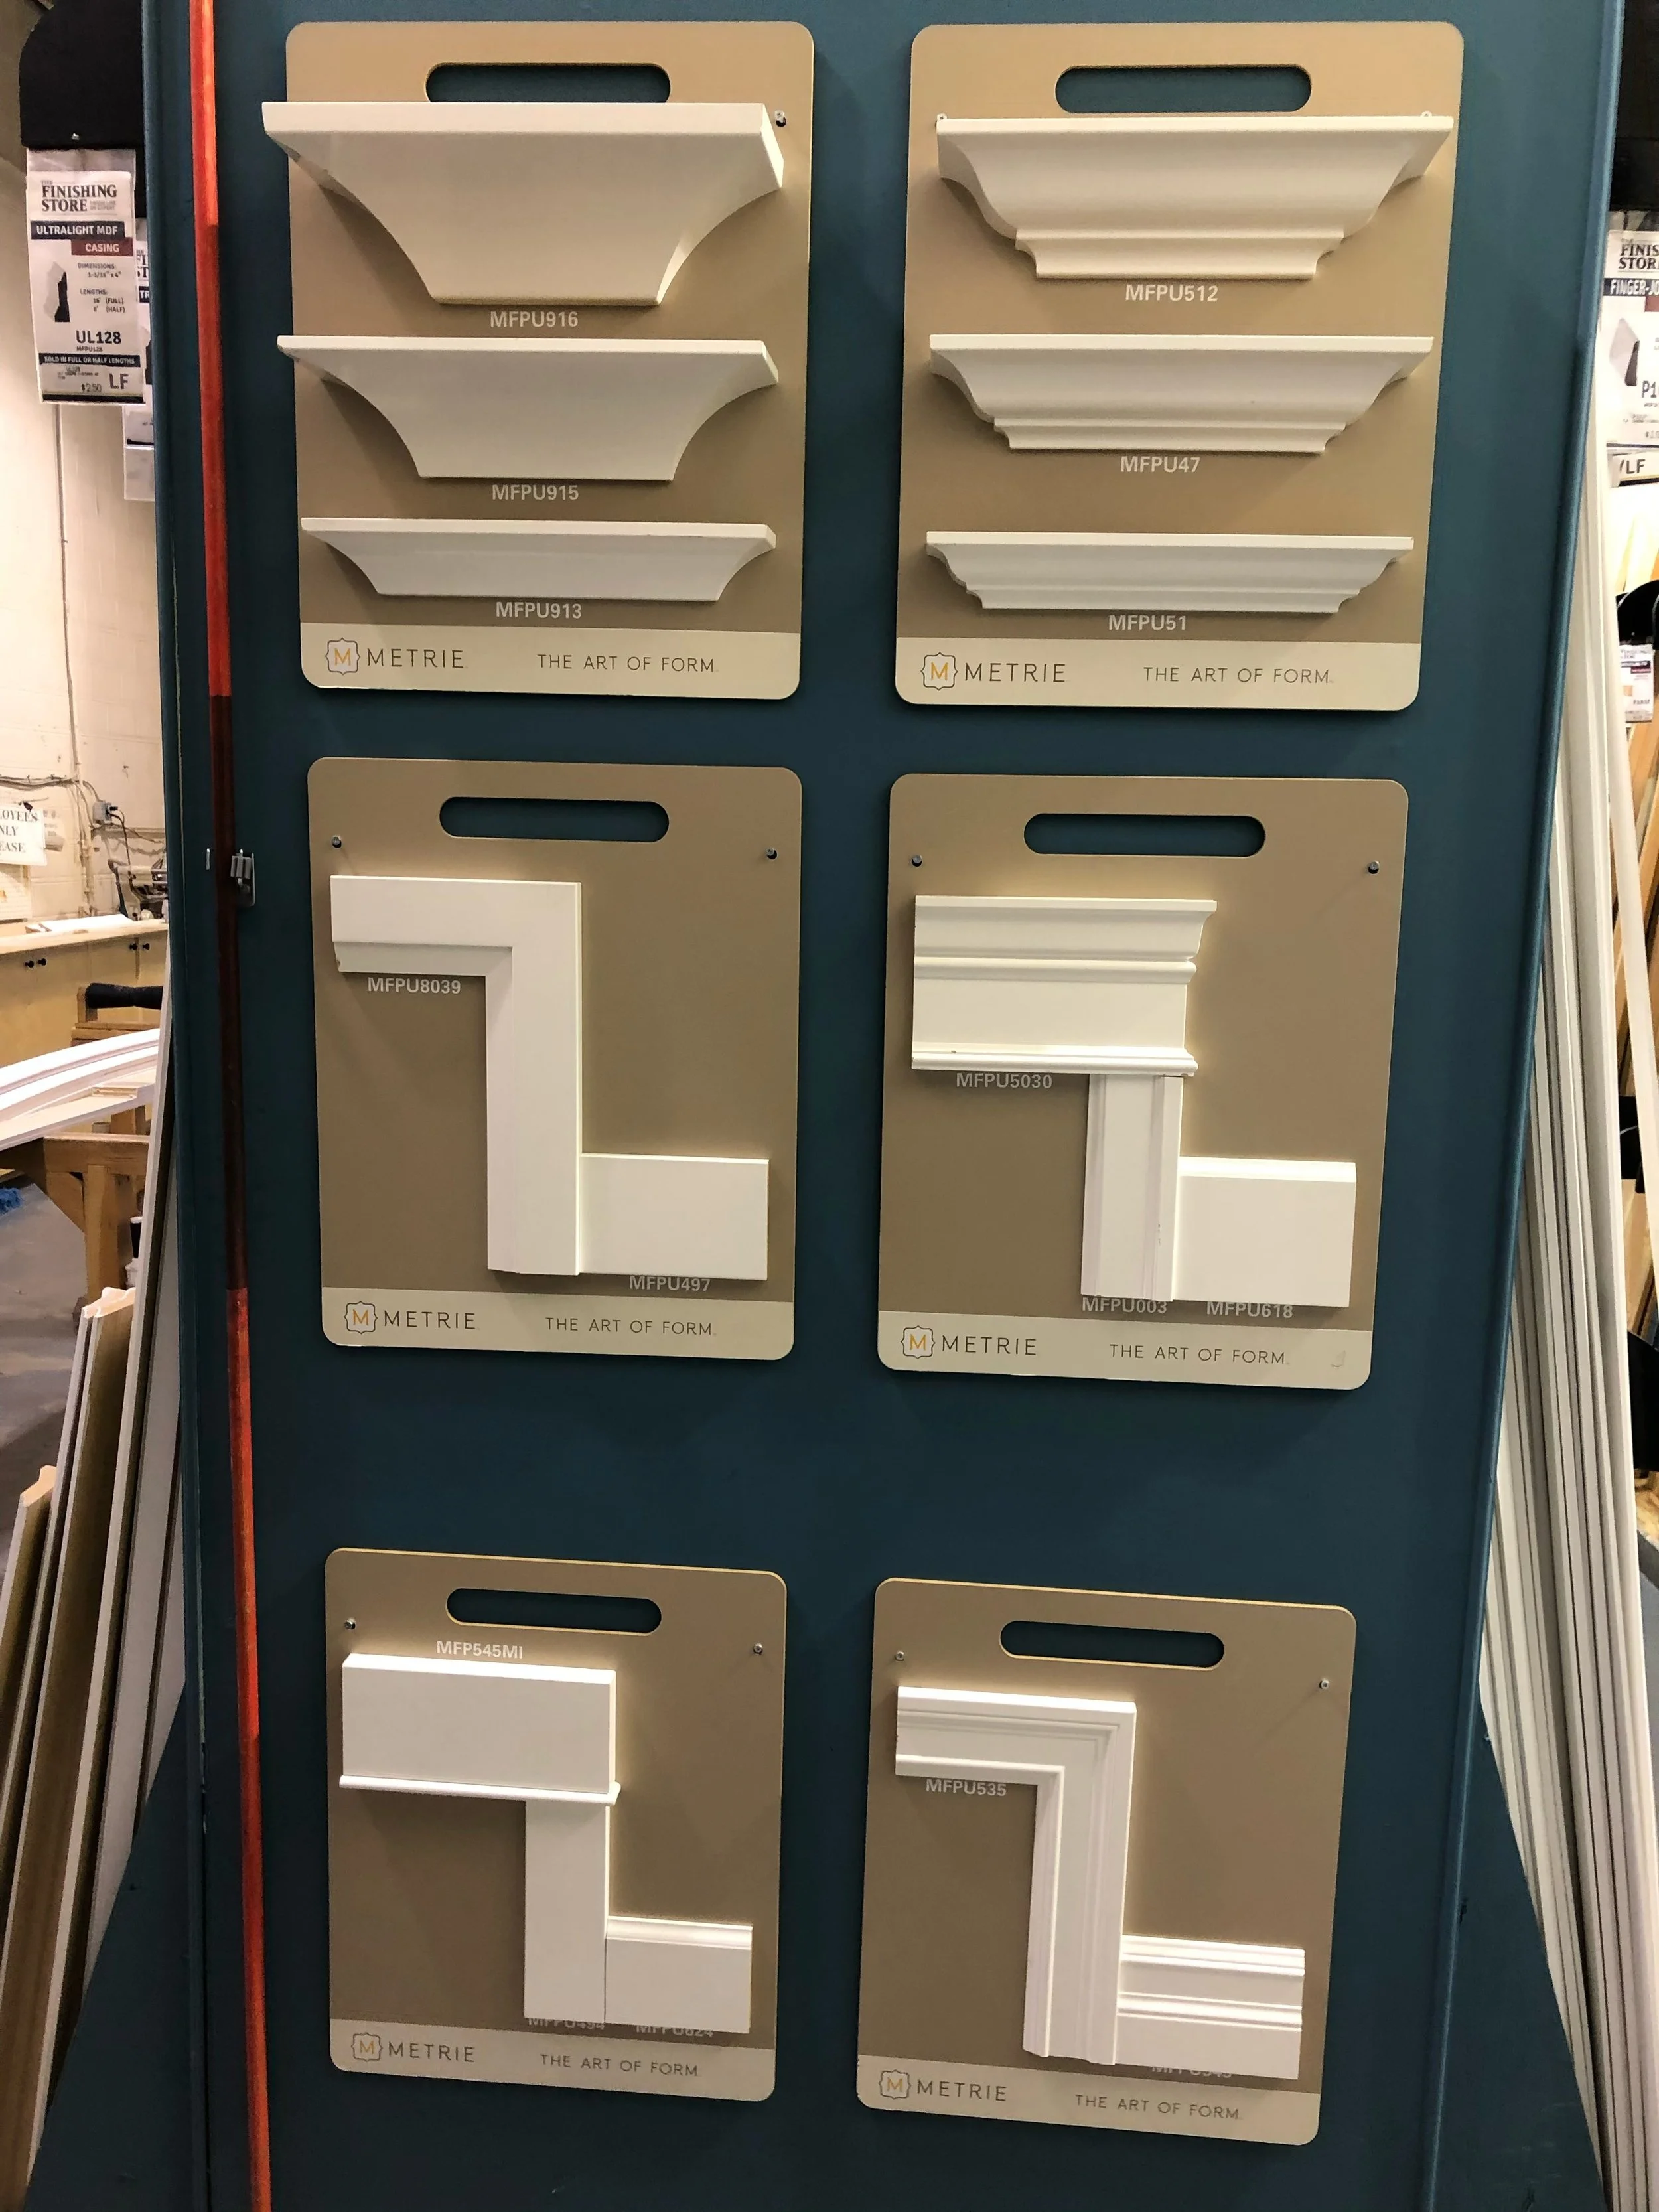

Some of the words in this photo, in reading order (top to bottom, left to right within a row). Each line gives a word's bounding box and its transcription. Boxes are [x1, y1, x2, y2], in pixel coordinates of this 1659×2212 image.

[41, 184, 117, 198] FINISHING
[41, 198, 88, 212] STORE
[36, 225, 94, 235] ULTRALIGHT
[96, 225, 118, 235] MDF
[85, 243, 120, 253] CASING
[1125, 283, 1219, 303] MFPU512
[490, 311, 579, 328] MFPU916
[76, 329, 122, 344] UL128
[109, 373, 129, 390] LF
[1120, 456, 1200, 473] MFPU47
[492, 484, 579, 501] MFPU915
[496, 601, 582, 619] MFPU913
[1108, 615, 1187, 631] MFPU51
[366, 648, 464, 669] METRIE
[537, 654, 573, 670] THE
[583, 655, 618, 670] ART
[627, 656, 652, 671] OF
[661, 657, 714, 673] FORM
[964, 662, 1066, 683] METRIE
[1143, 666, 1180, 682] THE
[1190, 667, 1228, 682] ART
[1237, 668, 1263, 683] OF
[1273, 668, 1329, 684] FORM
[0, 810, 40, 822] OYEES
[367, 976, 462, 995] MFPU8039
[956, 1072, 1053, 1090] MFPU5030
[629, 1275, 711, 1292] MFPU497
[1082, 1297, 1168, 1315] MFPU003
[1206, 1301, 1294, 1319] MFPU618
[384, 1309, 476, 1330] METRIE
[545, 1317, 579, 1331] THE
[589, 1319, 622, 1333] ART
[630, 1320, 653, 1334] OF
[662, 1321, 712, 1336] FORM
[942, 1335, 1037, 1356] METRIE
[1109, 1343, 1144, 1359] THE
[1154, 1346, 1190, 1361] ART
[1198, 1347, 1223, 1362] OF
[1232, 1349, 1285, 1365] FORM
[436, 1639, 524, 1660] MFP545MI
[926, 1778, 1007, 1797] MFPU535
[388, 2040, 476, 2063] METRIE
[540, 2053, 572, 2068] THE
[580, 2057, 612, 2071] ART
[619, 2059, 642, 2073] OF
[650, 2061, 698, 2077] FORM
[916, 2079, 1007, 2102] METRIE
[1075, 2094, 1108, 2109] THE
[1117, 2098, 1150, 2112] ART
[1157, 2101, 1181, 2115] OF
[1189, 2104, 1240, 2120] FORM
